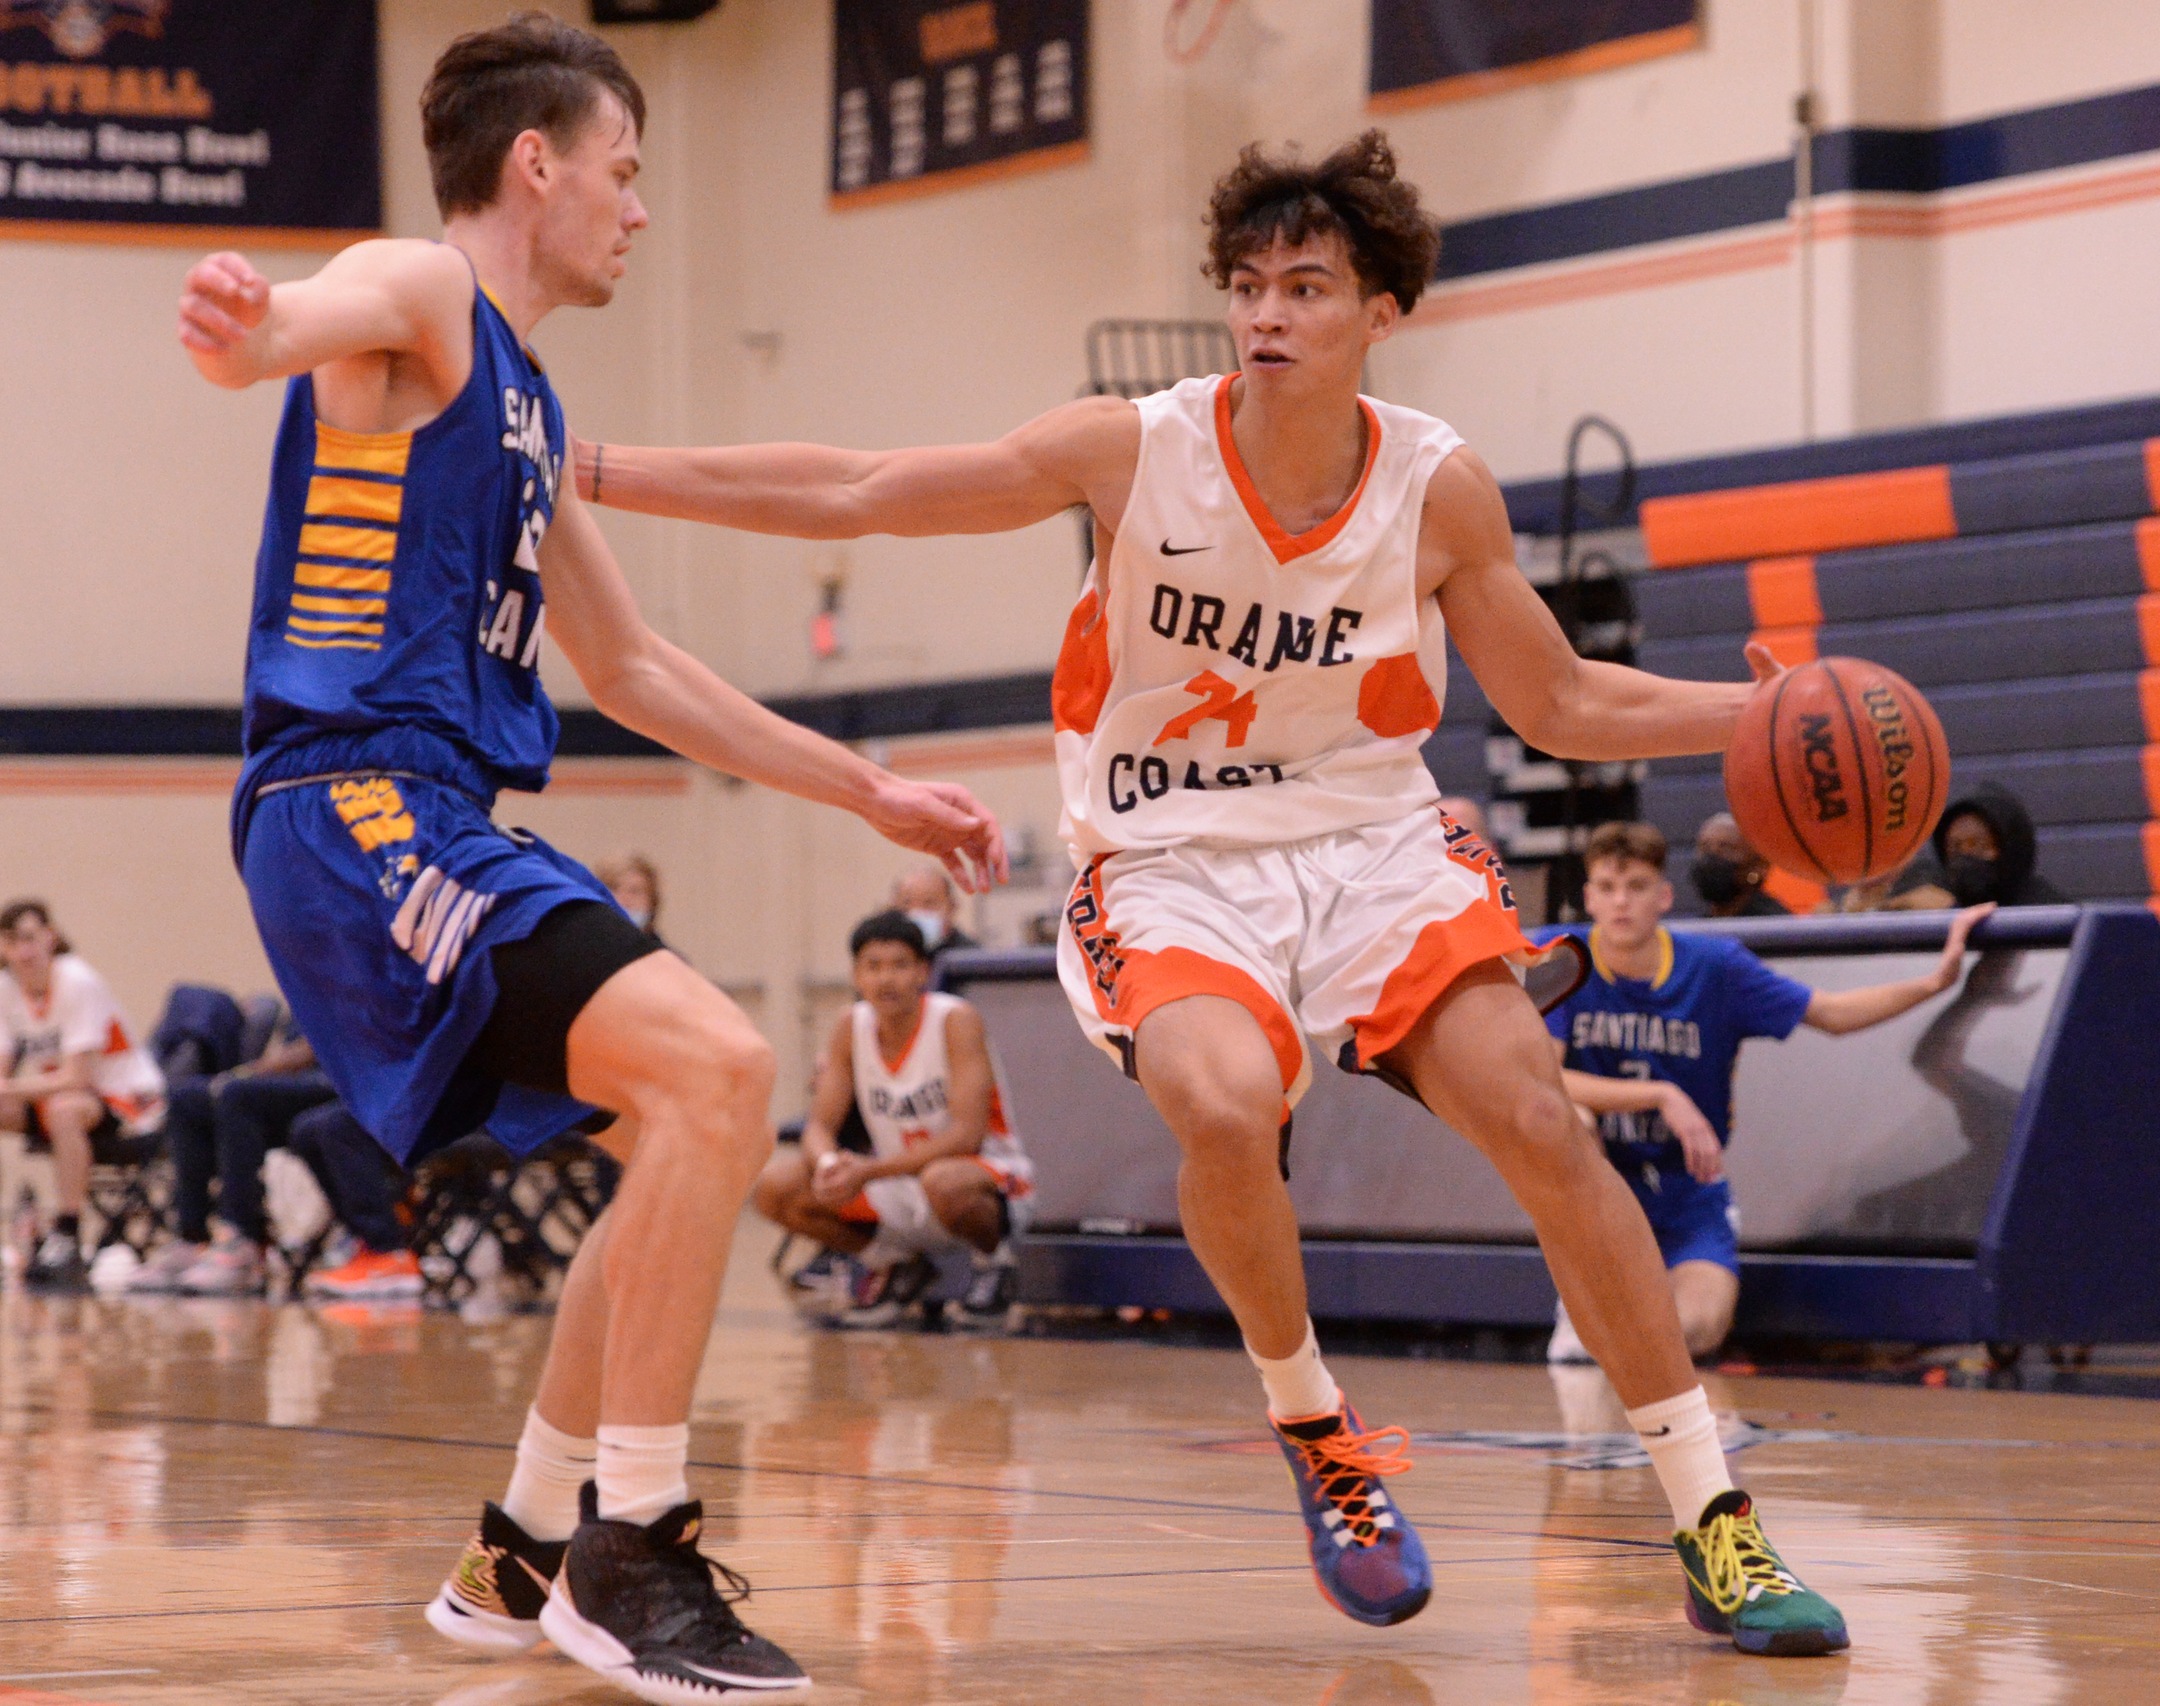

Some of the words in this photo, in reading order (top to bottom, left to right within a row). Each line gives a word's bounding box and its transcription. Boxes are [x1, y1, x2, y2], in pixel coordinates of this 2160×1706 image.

[1800, 713, 1848, 823] NCAA
[1862, 686, 1915, 832] Wilson
[1572, 1010, 1701, 1061] SANTIAGO
